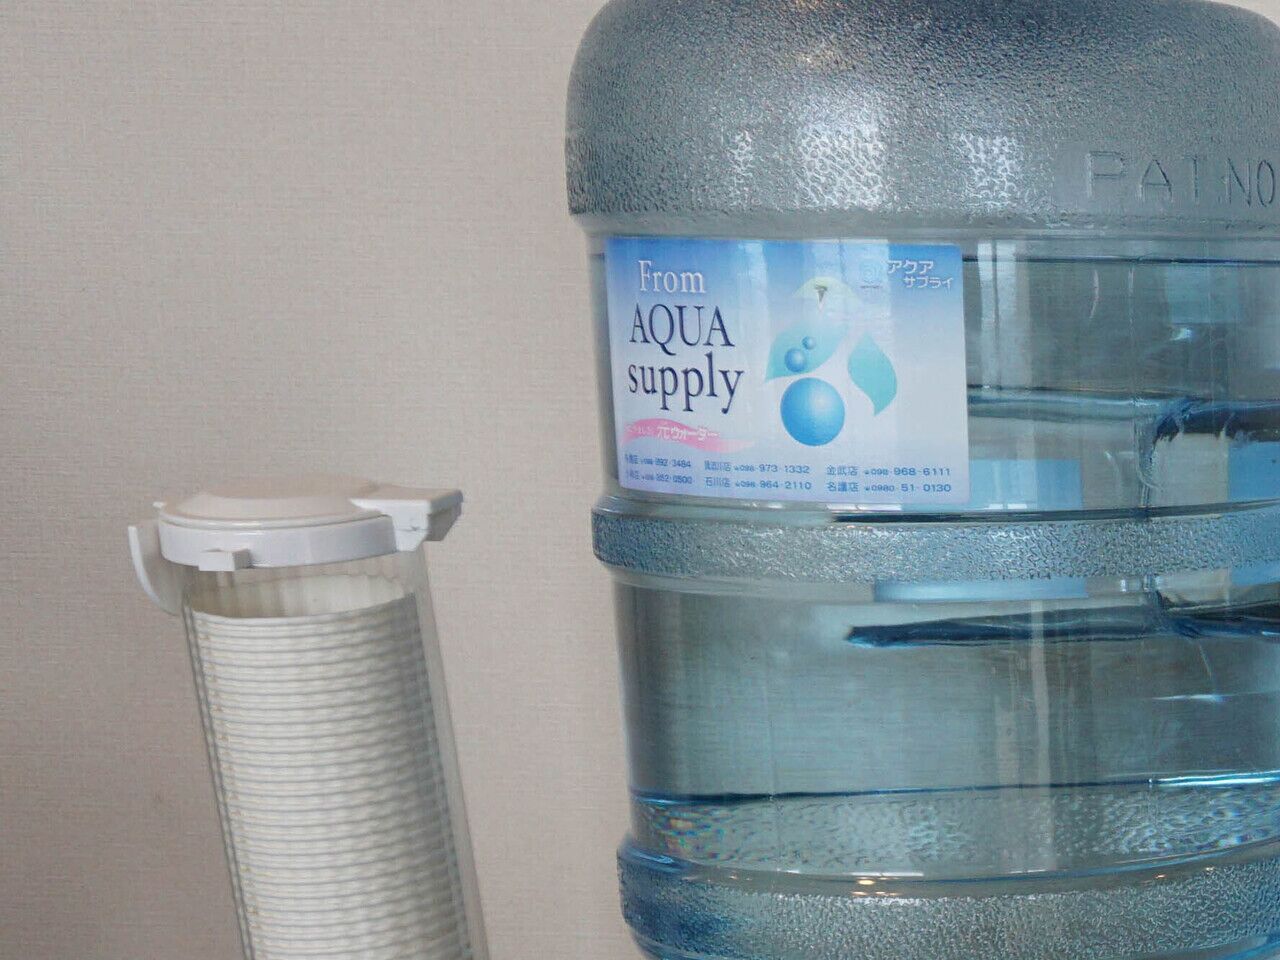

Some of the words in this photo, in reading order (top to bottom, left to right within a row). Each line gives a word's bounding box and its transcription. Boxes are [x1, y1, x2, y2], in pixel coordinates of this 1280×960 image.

[638, 260, 706, 293] From
[887, 260, 934, 274] アクア
[629, 303, 735, 356] AQUA
[628, 350, 745, 414] supply
